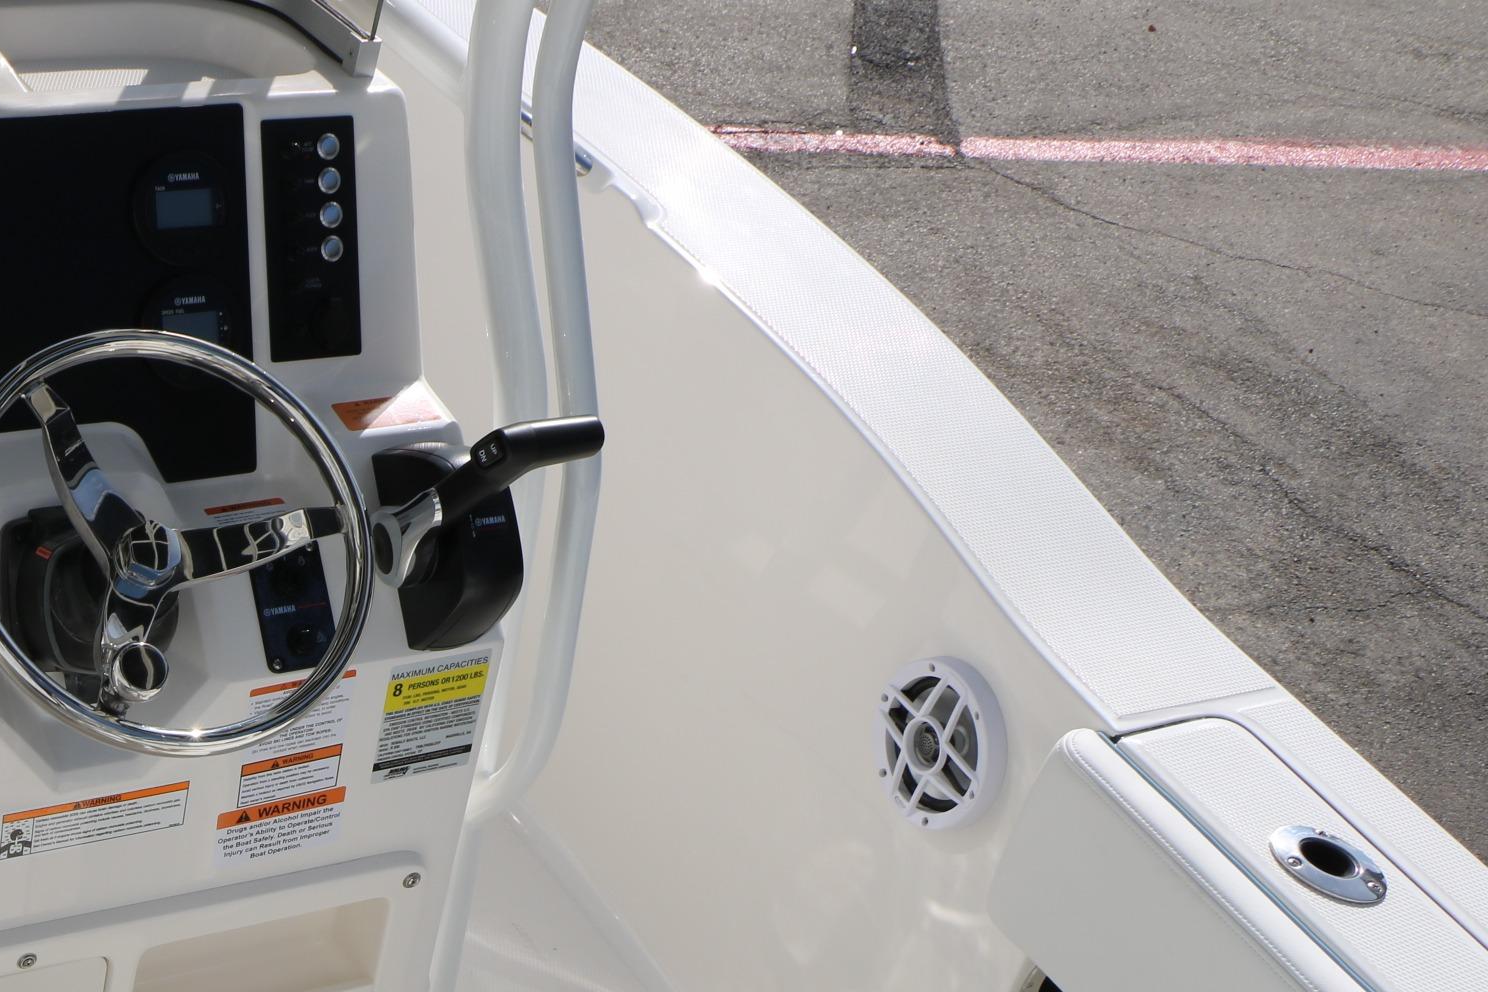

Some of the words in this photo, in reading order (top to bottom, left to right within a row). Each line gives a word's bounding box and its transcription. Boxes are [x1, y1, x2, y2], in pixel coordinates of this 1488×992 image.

[174, 171, 200, 182] YAMAHA
[180, 295, 206, 305] YAMAHA
[479, 449, 487, 463] DN
[490, 443, 498, 456] UP
[482, 514, 507, 527] YAMAHA
[270, 604, 297, 616] YAMAHA
[392, 666, 435, 681] MAXIMUM
[437, 656, 489, 673] CAPACITIES
[392, 683, 403, 697] 8
[408, 678, 439, 690] PERSONS
[452, 673, 468, 682] 1200
[469, 670, 484, 679] LBS.
[282, 752, 314, 765] WARNING
[81, 794, 122, 808] WARNING
[258, 794, 327, 818] WARNING
[217, 832, 254, 845] Operator's
[255, 826, 277, 836] Ability
[287, 812, 341, 829] Operate/Control
[226, 827, 247, 835] Drugs
[249, 821, 271, 830] and/or
[273, 815, 299, 824] Alcohol
[300, 810, 322, 820] Impair
[235, 840, 252, 848] Boat
[253, 834, 275, 844] Safely.
[277, 829, 296, 838] Death
[307, 822, 333, 831] Serious
[223, 849, 243, 858] Injury
[259, 839, 281, 850] Result
[282, 836, 298, 844] from
[299, 830, 330, 841] Improper
[267, 843, 302, 855] Operation.
